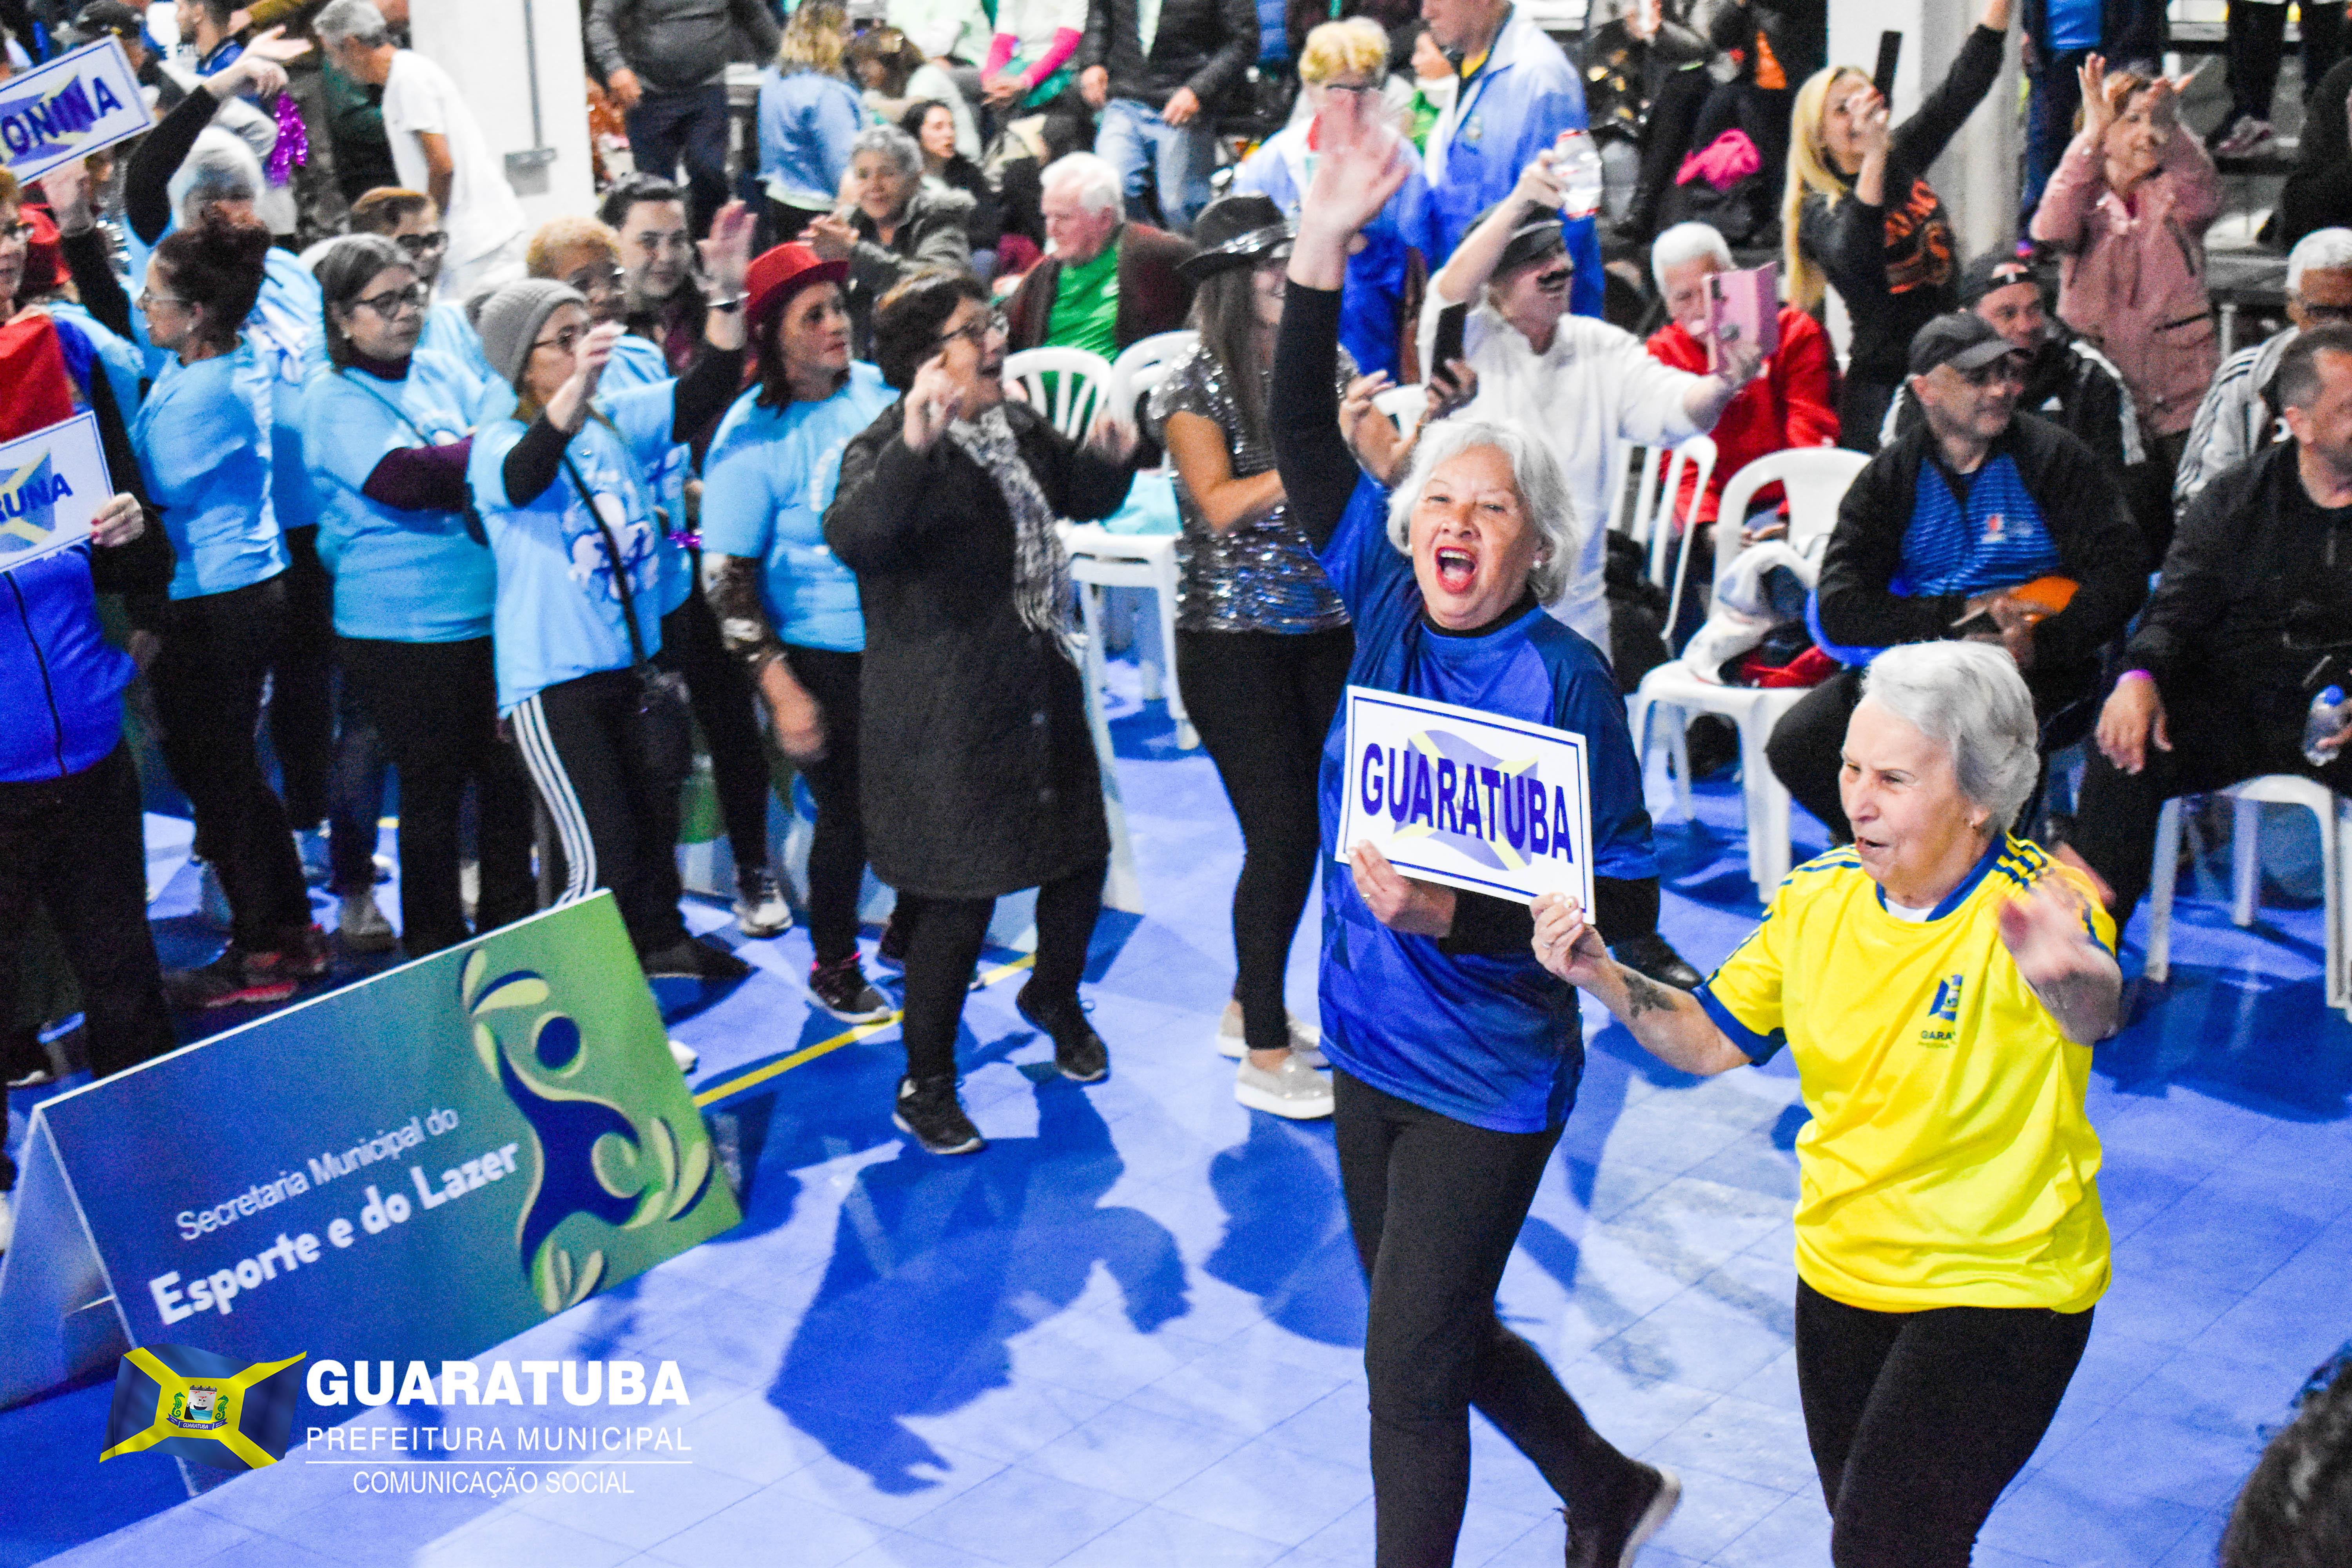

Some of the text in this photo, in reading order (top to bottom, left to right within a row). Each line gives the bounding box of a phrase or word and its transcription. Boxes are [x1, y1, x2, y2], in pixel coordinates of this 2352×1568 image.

[1361, 743, 1573, 864] GUARATUBA
[149, 1142, 519, 1325] Esporte e do Lazer
[176, 1107, 459, 1241] Secretaria Municipal do
